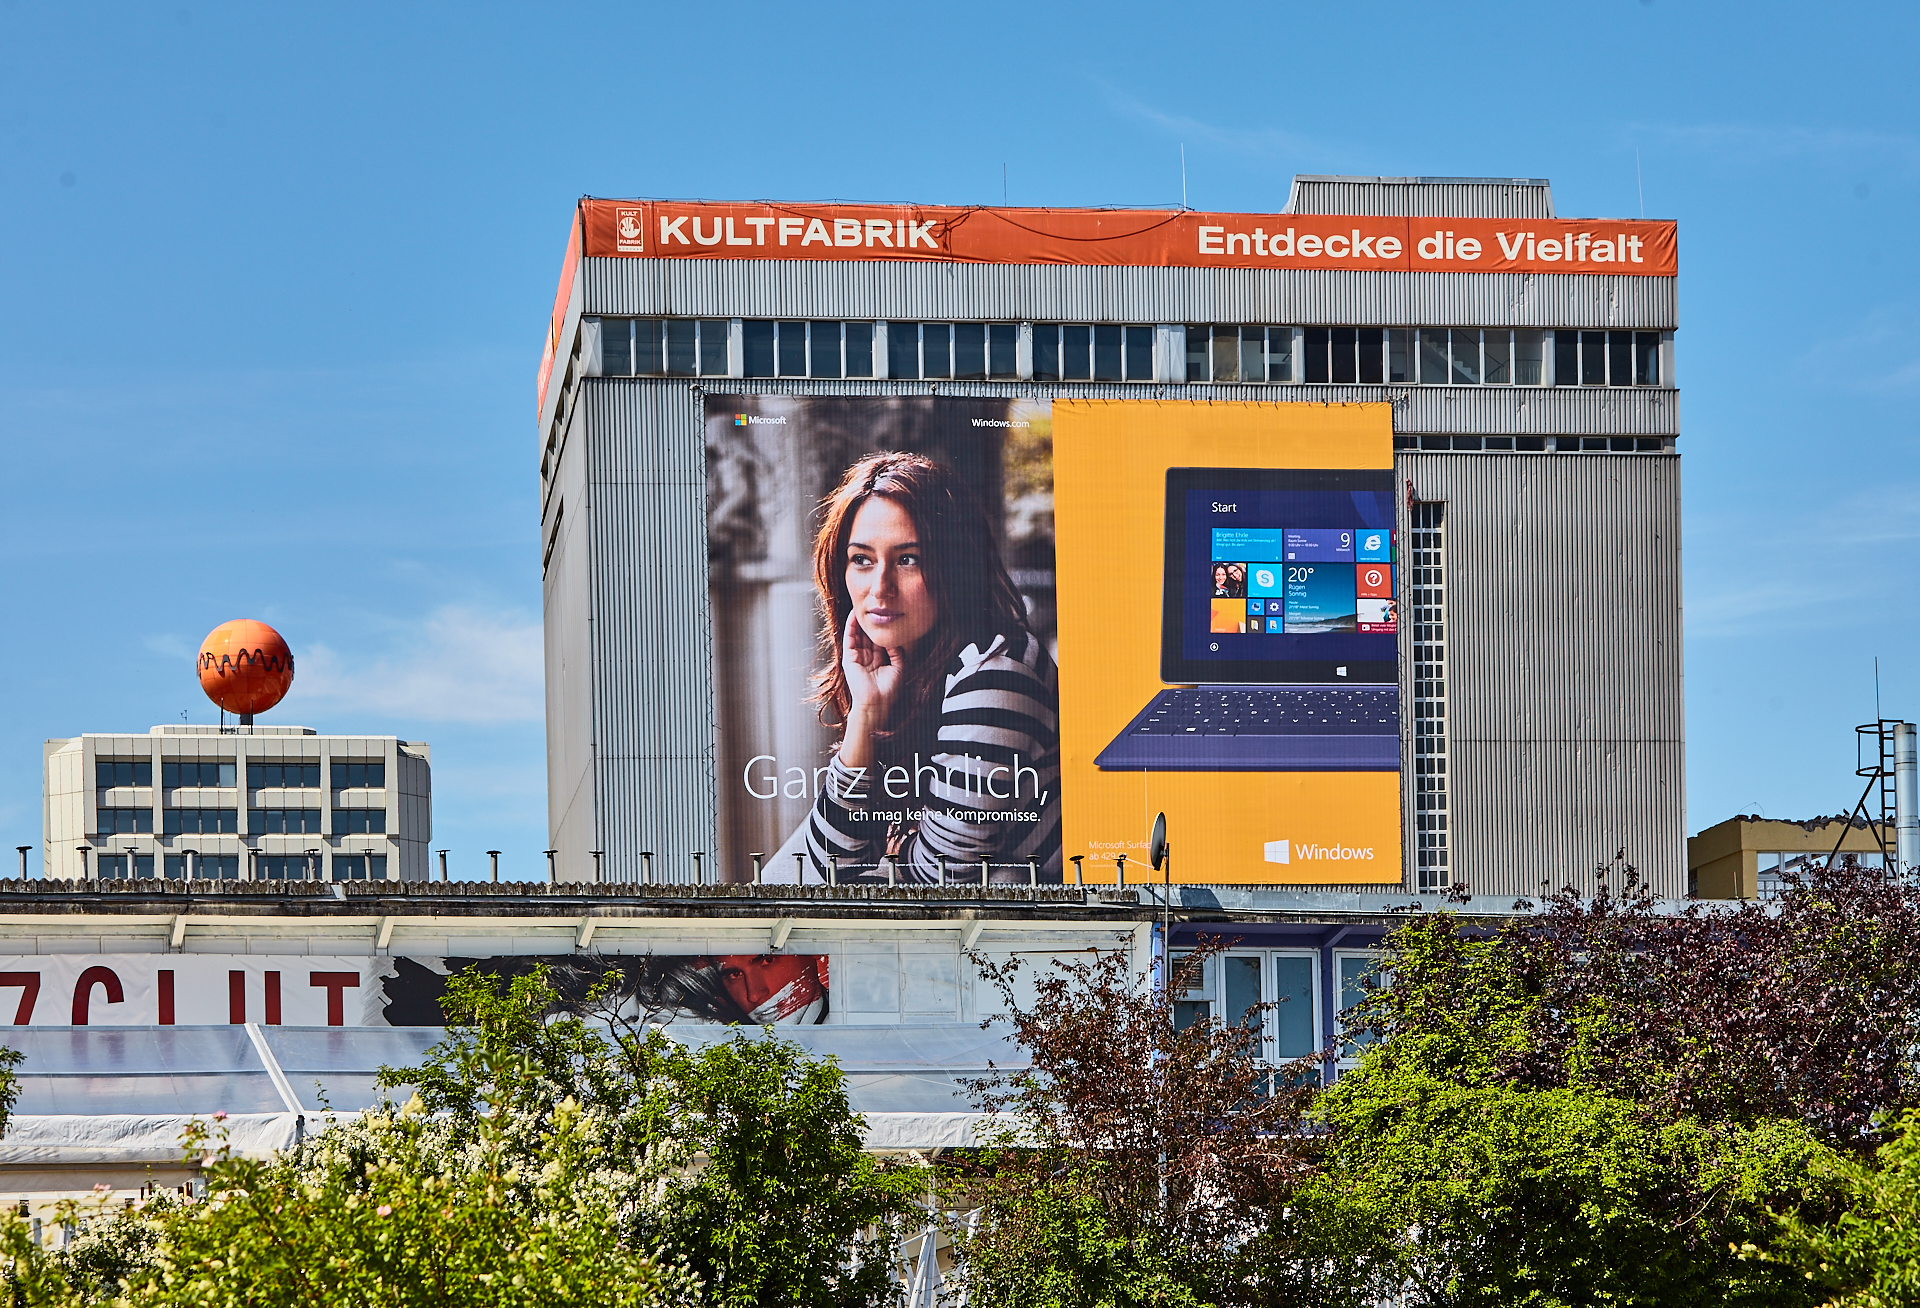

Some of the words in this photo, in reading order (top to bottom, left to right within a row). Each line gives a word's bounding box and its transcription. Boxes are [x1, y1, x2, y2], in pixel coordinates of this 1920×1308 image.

[660, 215, 939, 249] KULTFABRIK
[1198, 226, 1403, 260] Entdecke
[1417, 230, 1482, 261] die
[1495, 231, 1644, 264] Vielfalt
[748, 415, 787, 426] Microsoft
[971, 417, 1030, 429] Windows.com
[1211, 501, 1238, 513] Start
[1340, 532, 1351, 548] 9
[1288, 567, 1315, 583] 20°
[743, 754, 868, 800] Ganz
[883, 752, 1049, 806] ehrlich,
[848, 808, 869, 823] ich
[872, 811, 903, 826] mag
[906, 808, 942, 823] keine
[946, 808, 1042, 826] Kompromisse.
[1088, 840, 1125, 849] Microsoft
[1126, 840, 1152, 850] Surfac
[1295, 843, 1374, 861] Windows
[1089, 852, 1100, 861] ab
